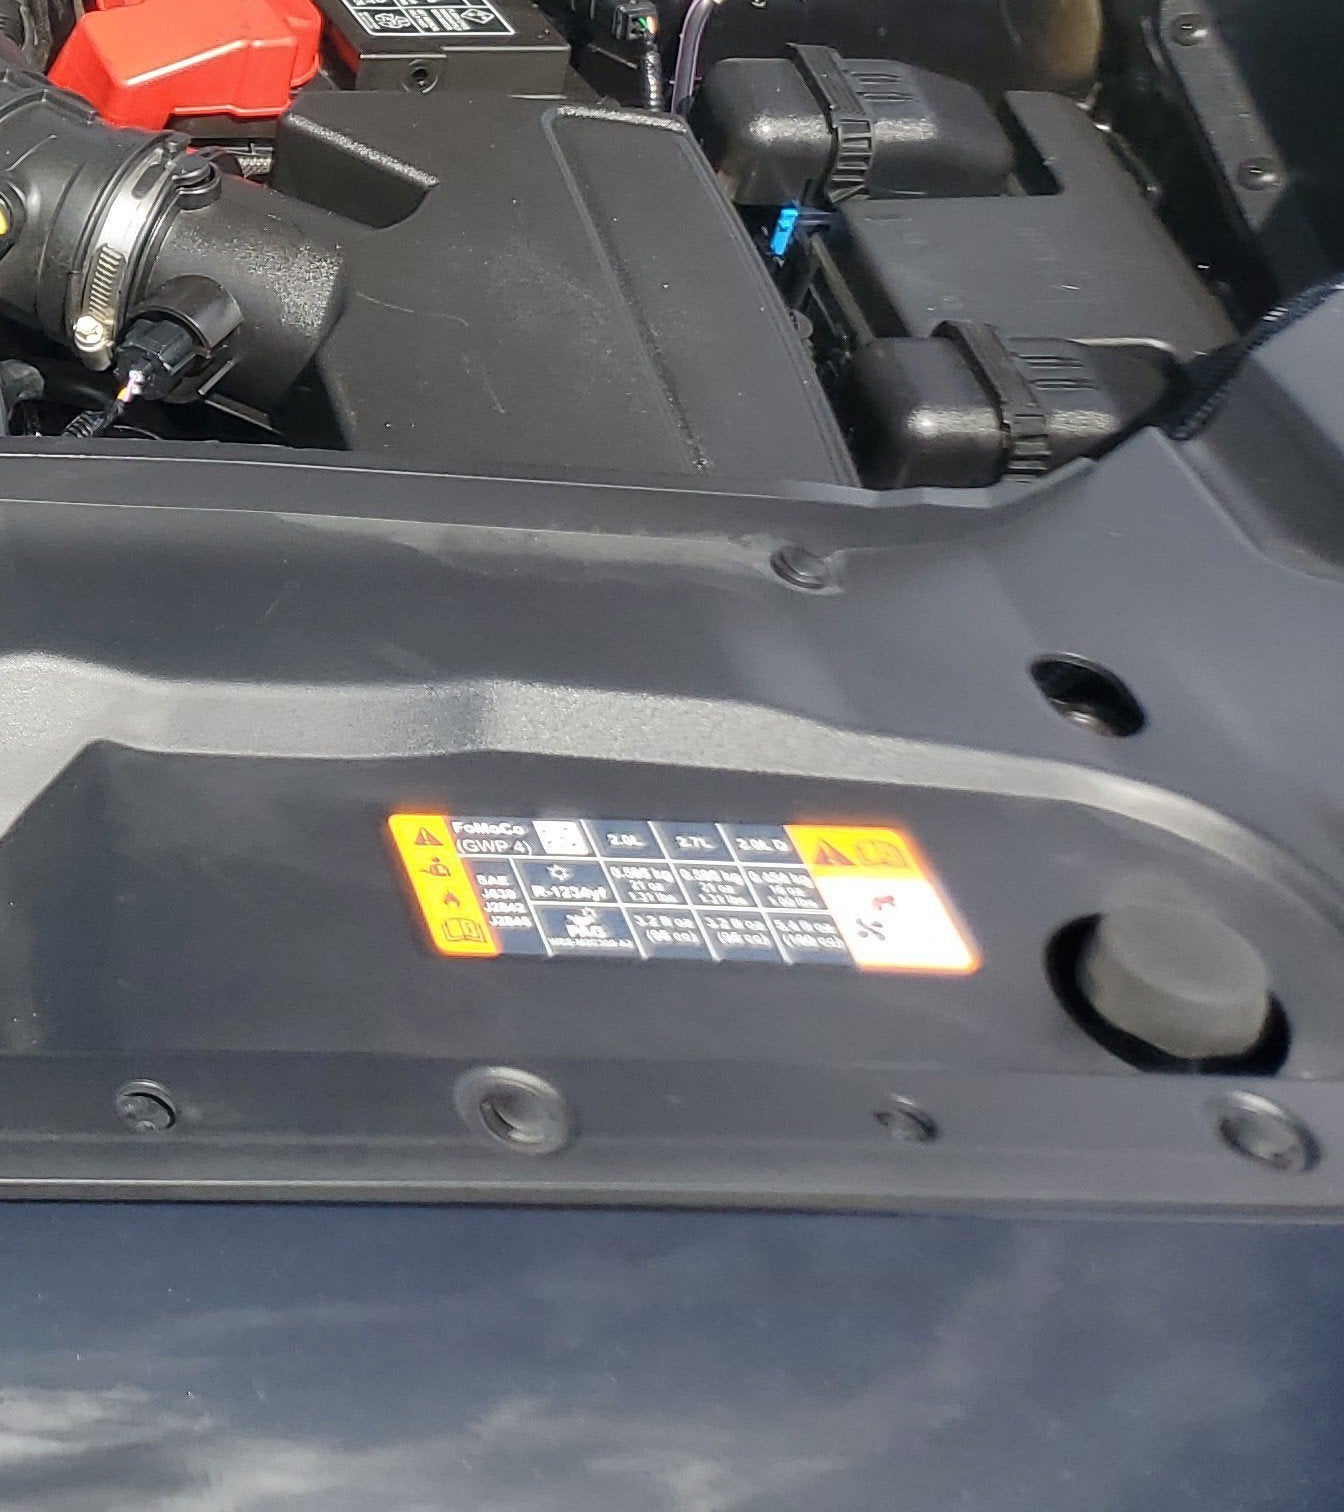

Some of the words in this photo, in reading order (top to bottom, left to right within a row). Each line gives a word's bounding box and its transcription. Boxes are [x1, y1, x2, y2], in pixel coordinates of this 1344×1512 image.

[451, 821, 526, 836] FoMoCo
[456, 839, 508, 855] (GWP
[513, 840, 533, 856] 4)
[607, 833, 645, 847] 2.0L
[675, 835, 714, 849] 2.7L
[476, 874, 510, 886] SAE
[651, 868, 674, 883] kg
[720, 870, 743, 885] kg
[789, 872, 814, 888] kg
[531, 885, 607, 901] R-1234yf
